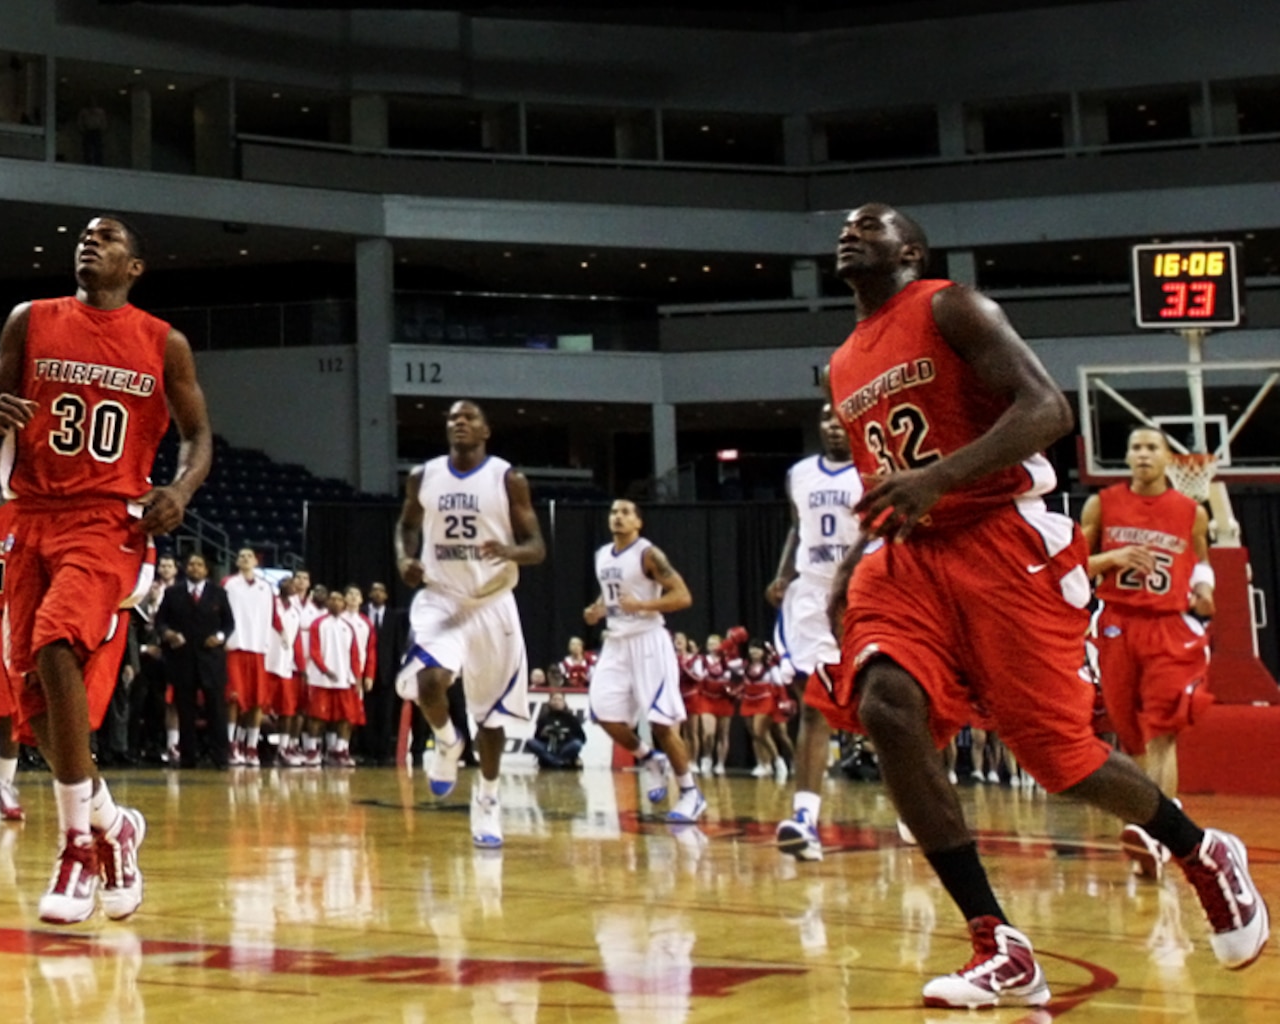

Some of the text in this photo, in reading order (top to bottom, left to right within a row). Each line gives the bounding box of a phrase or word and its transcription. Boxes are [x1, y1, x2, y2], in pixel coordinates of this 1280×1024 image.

[1153, 251, 1225, 277] 16:06
[1160, 281, 1216, 318] 33
[34, 357, 156, 397] FAIRFIELD
[318, 358, 343, 373] 112
[405, 362, 443, 383] 112
[48, 392, 129, 463] 30
[864, 402, 942, 476] 32
[444, 515, 477, 539] 25
[821, 513, 836, 537] 0
